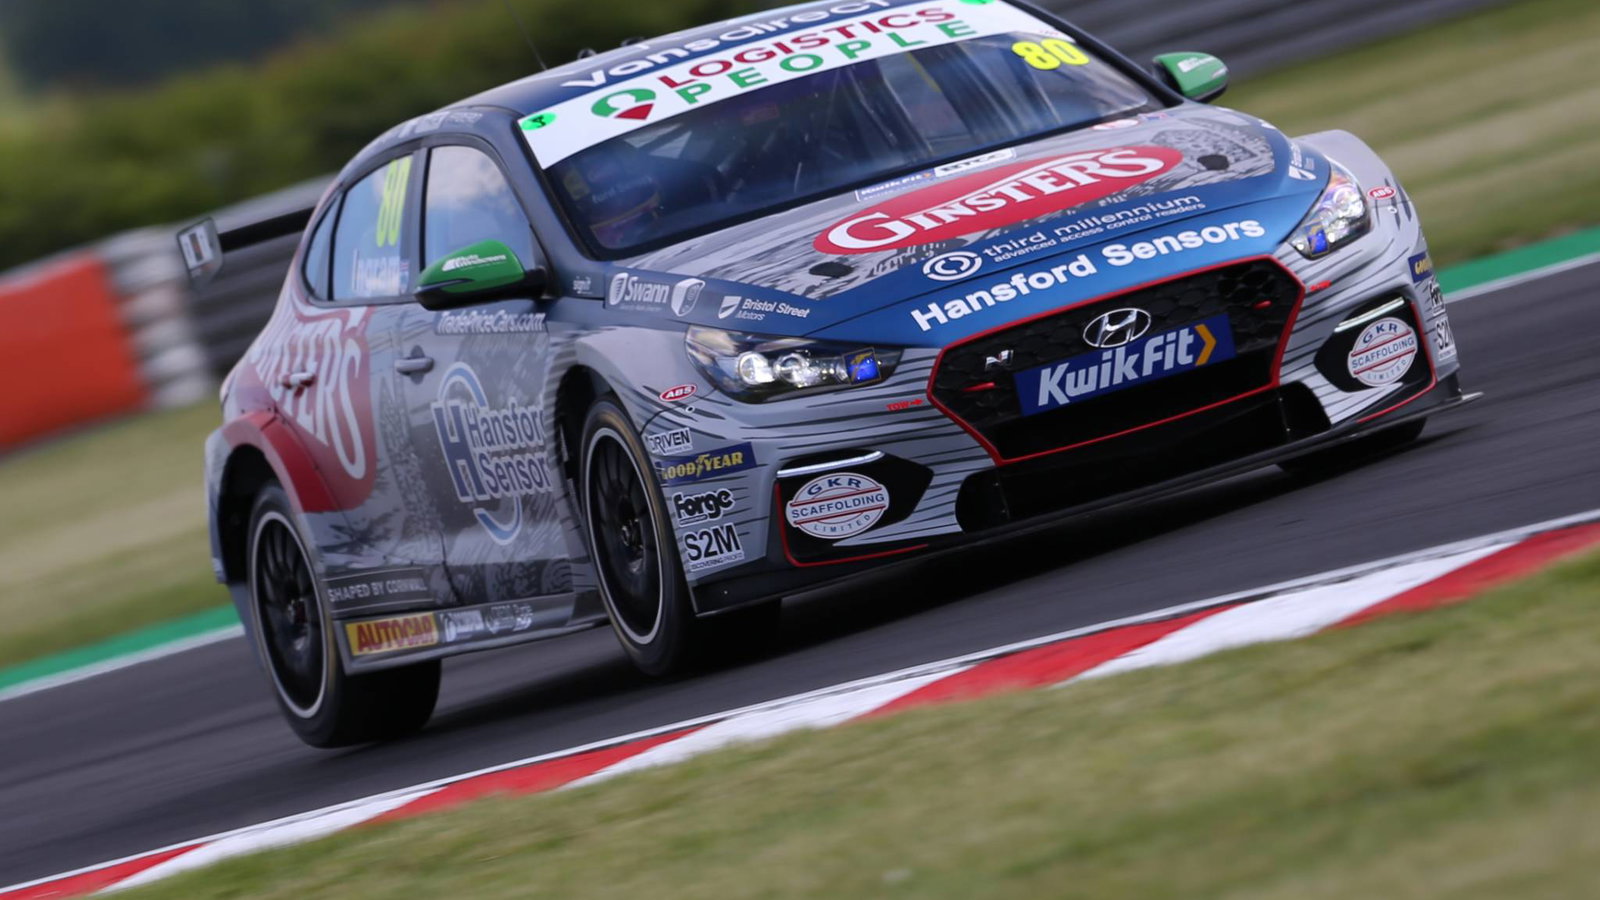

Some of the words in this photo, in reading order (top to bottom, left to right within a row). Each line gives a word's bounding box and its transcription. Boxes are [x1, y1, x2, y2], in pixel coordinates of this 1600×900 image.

[657, 8, 956, 88] LOGISTICS
[676, 20, 977, 104] PEOPLE
[1011, 38, 1090, 70] 80
[376, 155, 412, 247] 80
[1373, 187, 1392, 198] ABS
[983, 231, 1046, 257] third
[1054, 195, 1201, 237] millennium
[994, 238, 1056, 263] advanced
[1060, 227, 1104, 243] access
[1106, 213, 1152, 230] control
[1155, 202, 1206, 218] readers
[910, 254, 1098, 332] Hansford
[1101, 219, 1266, 267] Sensors
[624, 276, 670, 304] Swann
[735, 309, 766, 321] Motors
[742, 298, 777, 312] Bristol
[777, 302, 811, 318] Street
[1363, 323, 1398, 344] GKR
[1351, 337, 1415, 369] SCAFFOLDING
[1367, 359, 1407, 380] LIMITED
[664, 386, 693, 399] ABS
[807, 477, 862, 496] GKR
[791, 493, 885, 519] SCAFFOLDING
[814, 514, 871, 532] LIMITED
[684, 524, 741, 561] S2M
[327, 583, 370, 602] SHAPED
[371, 582, 385, 597] BY
[356, 615, 434, 653] AUTOCAR
